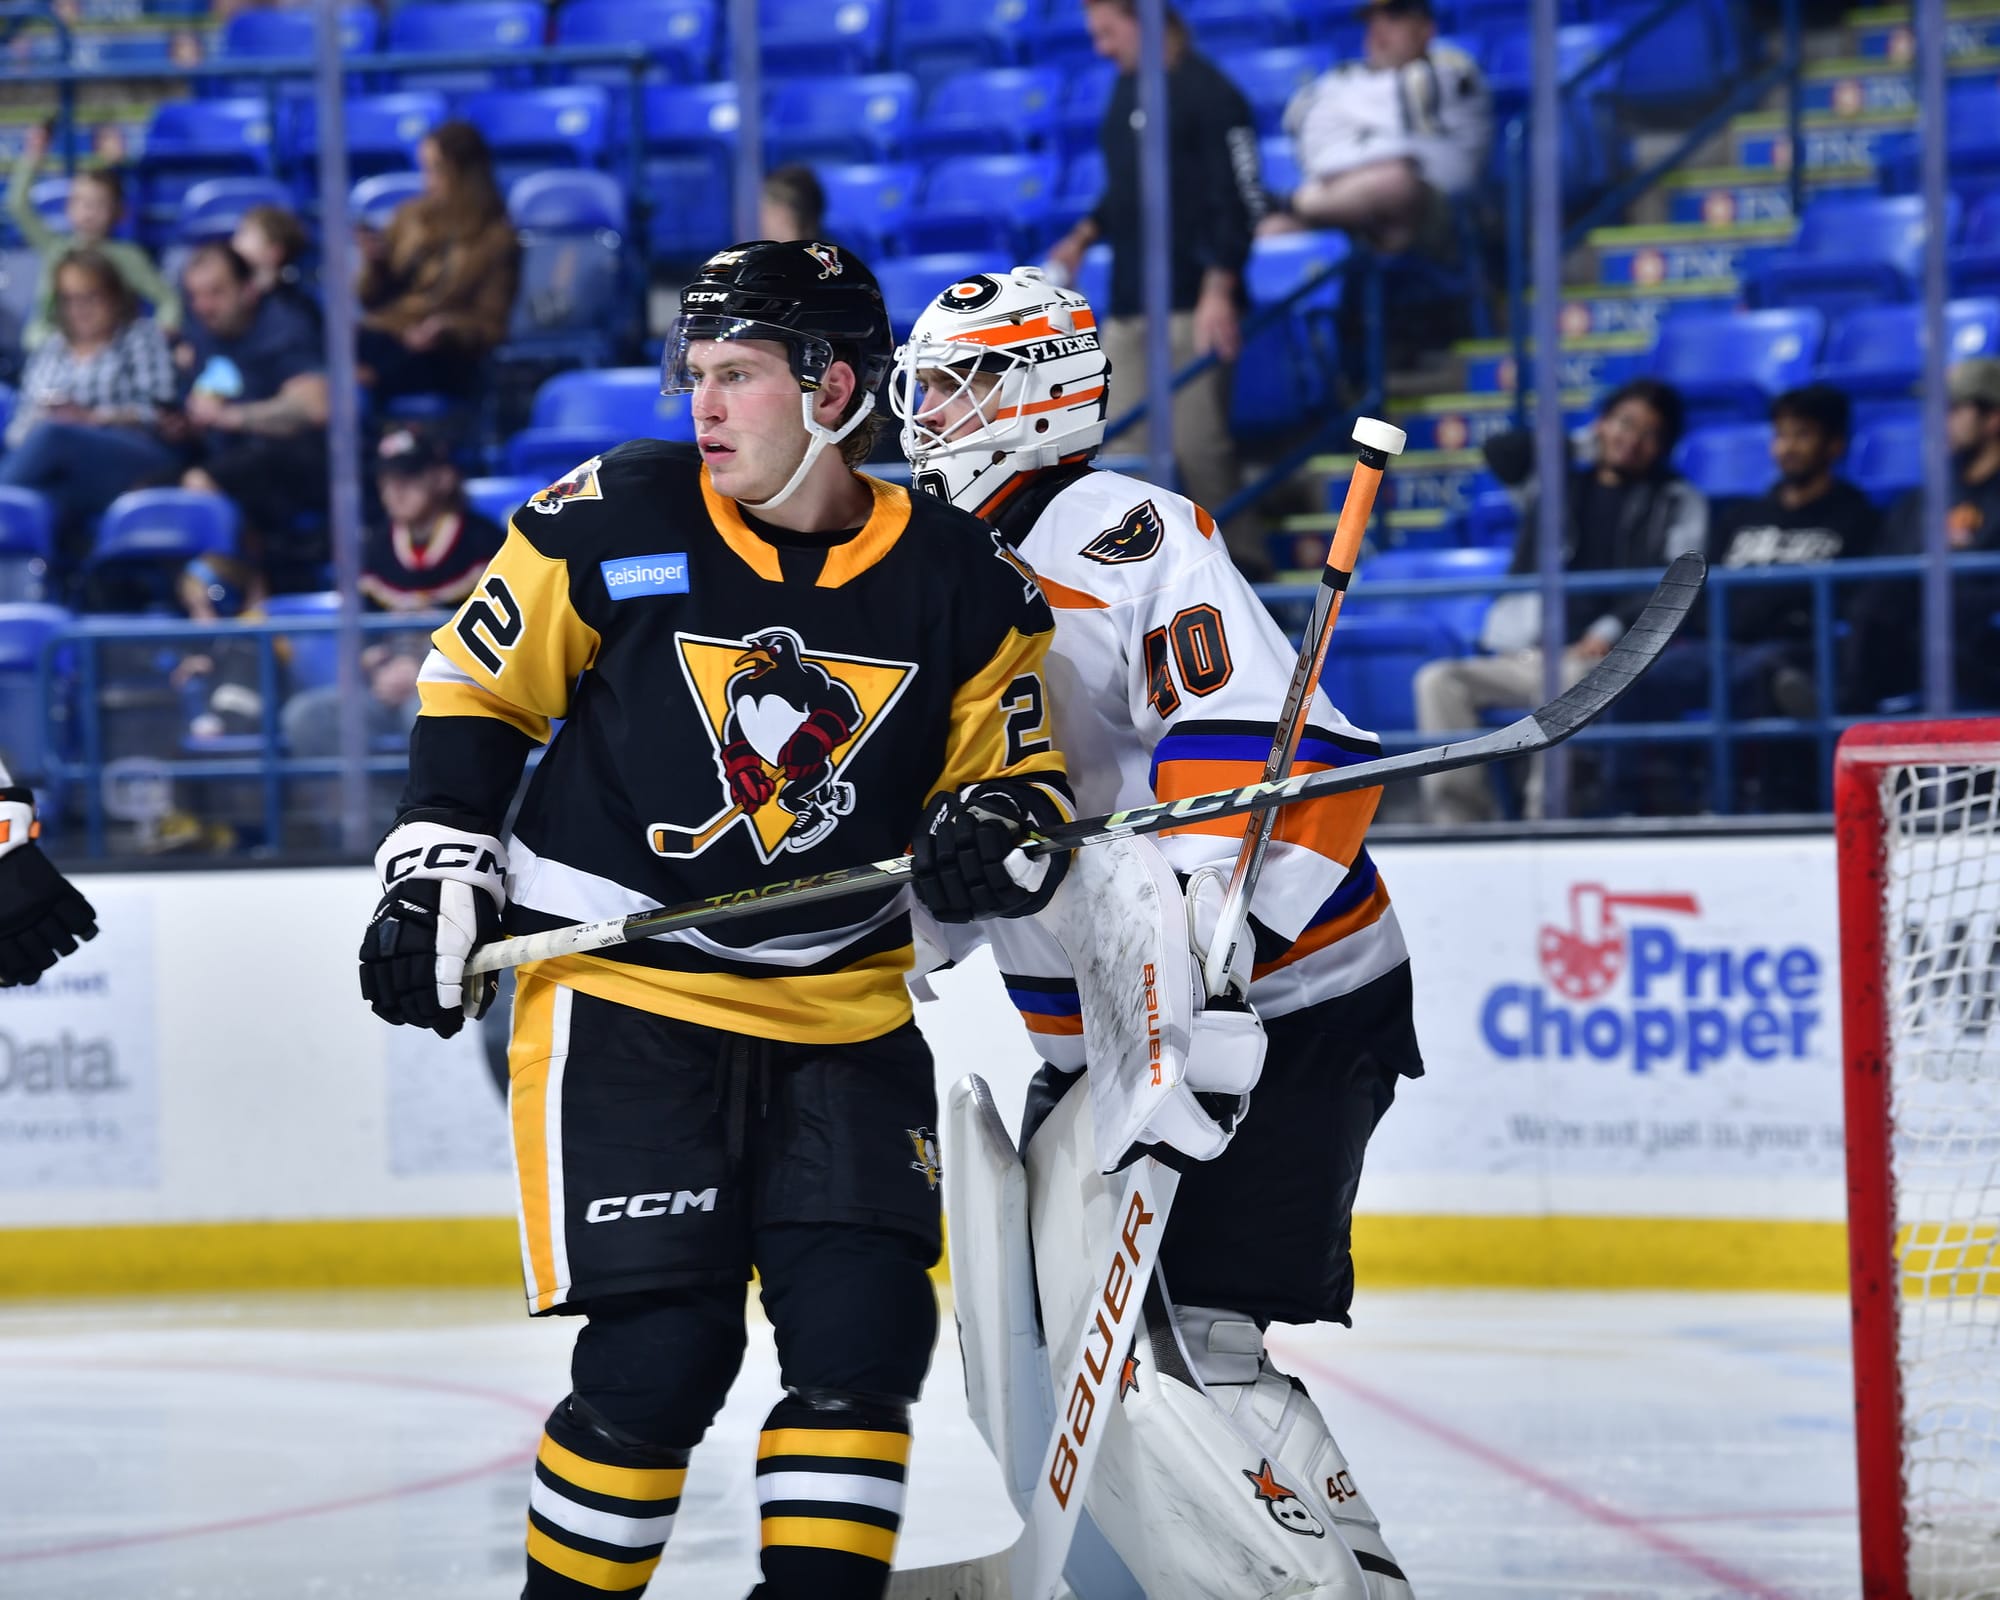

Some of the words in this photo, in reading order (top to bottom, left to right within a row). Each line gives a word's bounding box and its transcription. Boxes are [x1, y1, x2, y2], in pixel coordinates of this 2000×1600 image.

[687, 292, 729, 302] CCM
[1026, 334, 1100, 364] FLYERS
[800, 380, 821, 390] CCM
[605, 565, 685, 587] Geisinger
[1142, 602, 1234, 720] 40
[1104, 773, 1313, 832] CCM
[386, 843, 507, 885] CCM
[704, 868, 852, 910] TACKS
[1629, 926, 1821, 999] Price
[1480, 983, 1821, 1075] Chopper
[585, 1187, 719, 1224] CCM
[1326, 1470, 1357, 1504] 40
